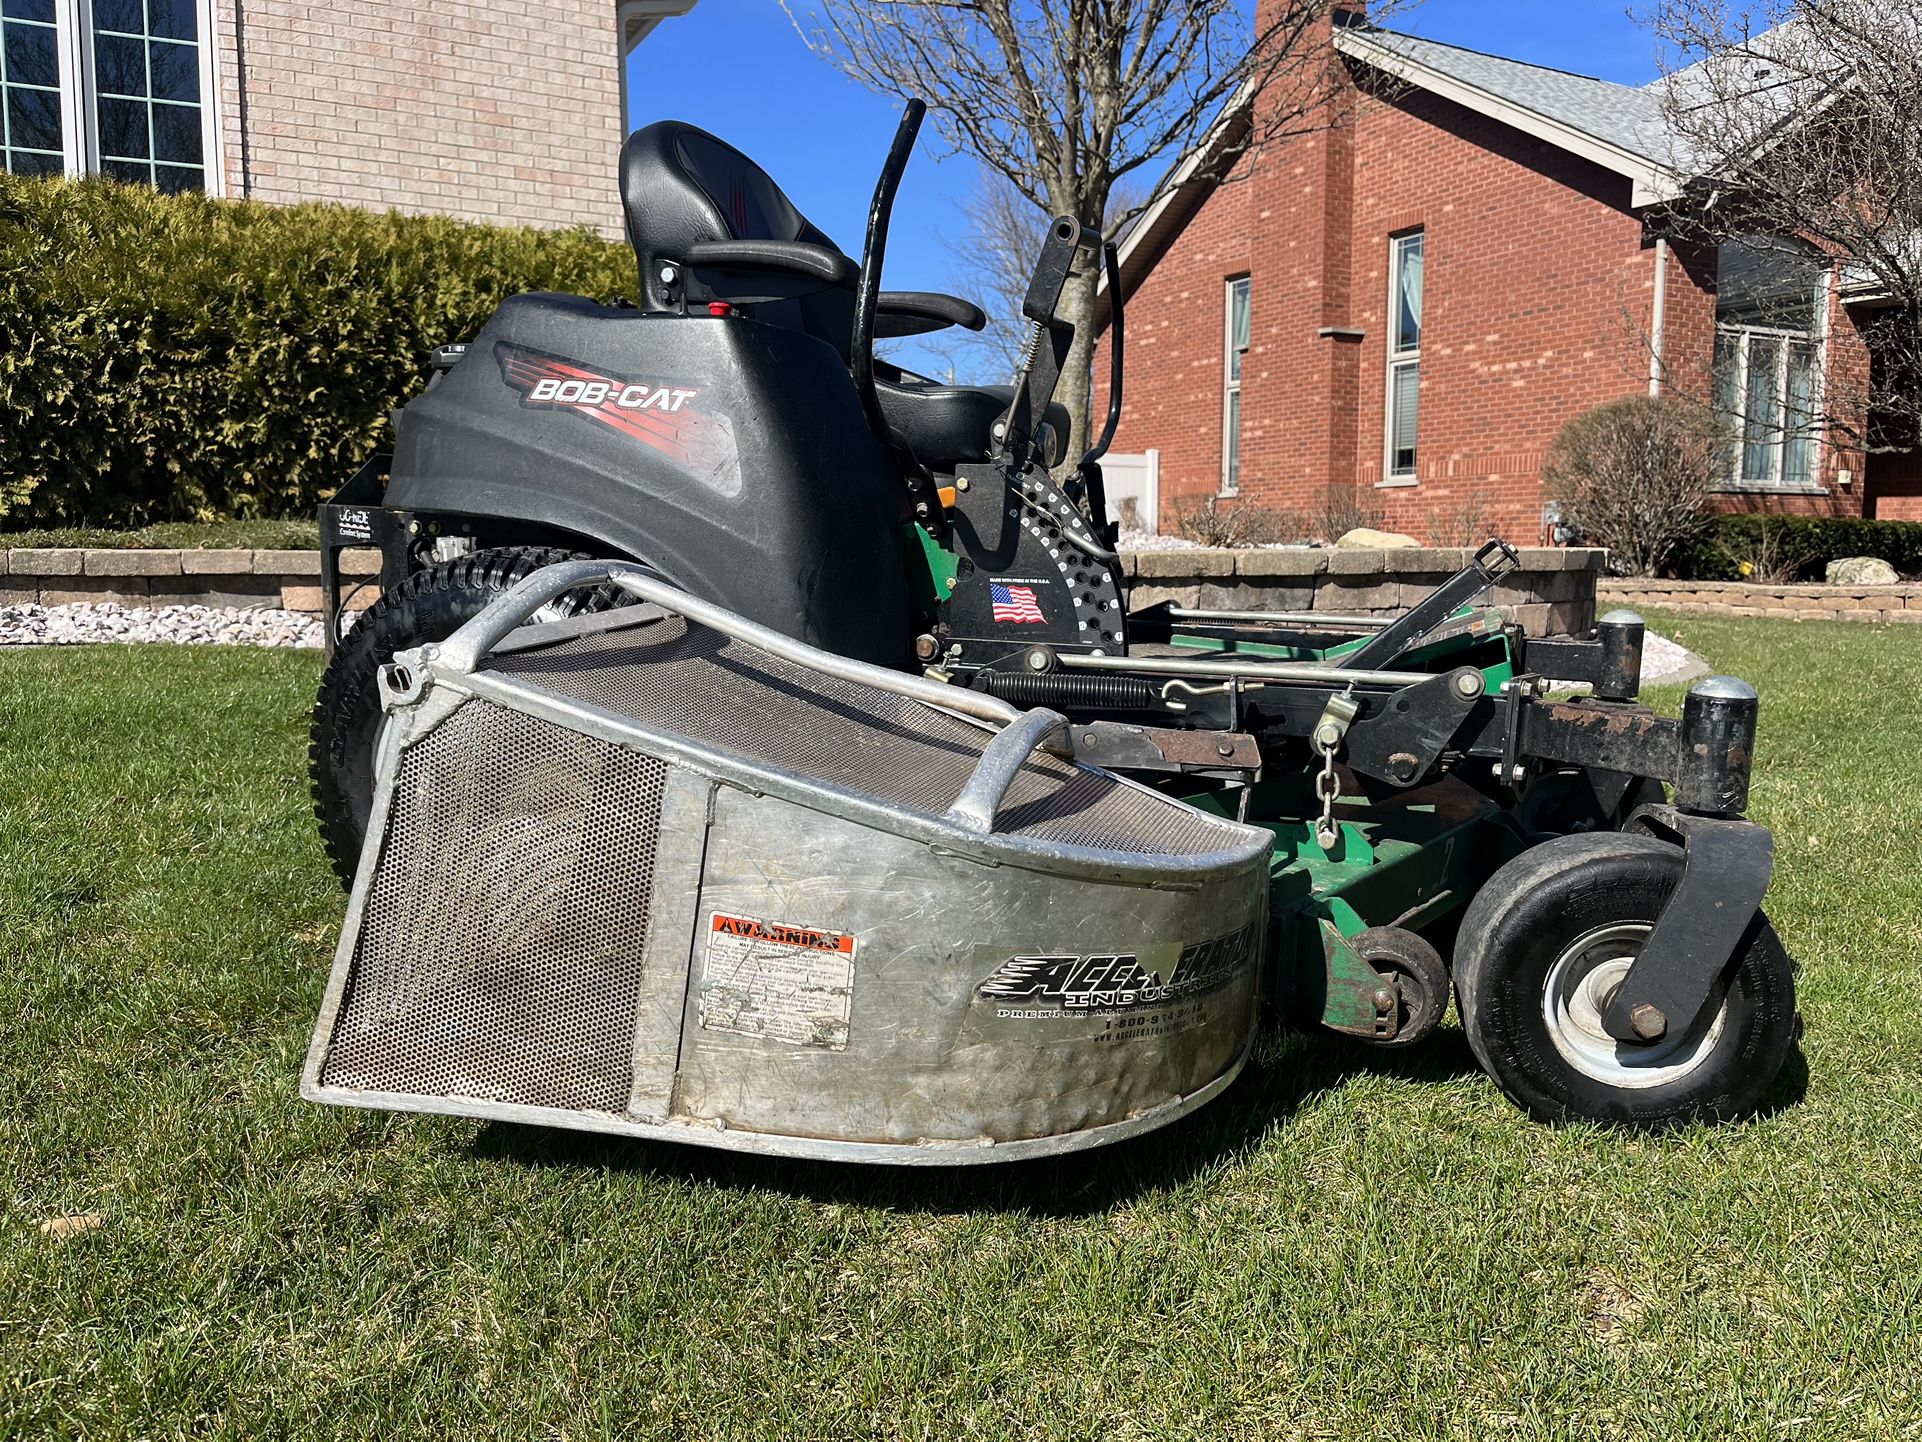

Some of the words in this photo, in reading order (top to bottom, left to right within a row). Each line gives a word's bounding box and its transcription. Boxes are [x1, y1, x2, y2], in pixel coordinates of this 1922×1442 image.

[529, 377, 698, 412] BOB-CAT
[1064, 966, 1234, 1007] INDUSTRIES
[997, 1009, 1089, 1019] PREMIUM
